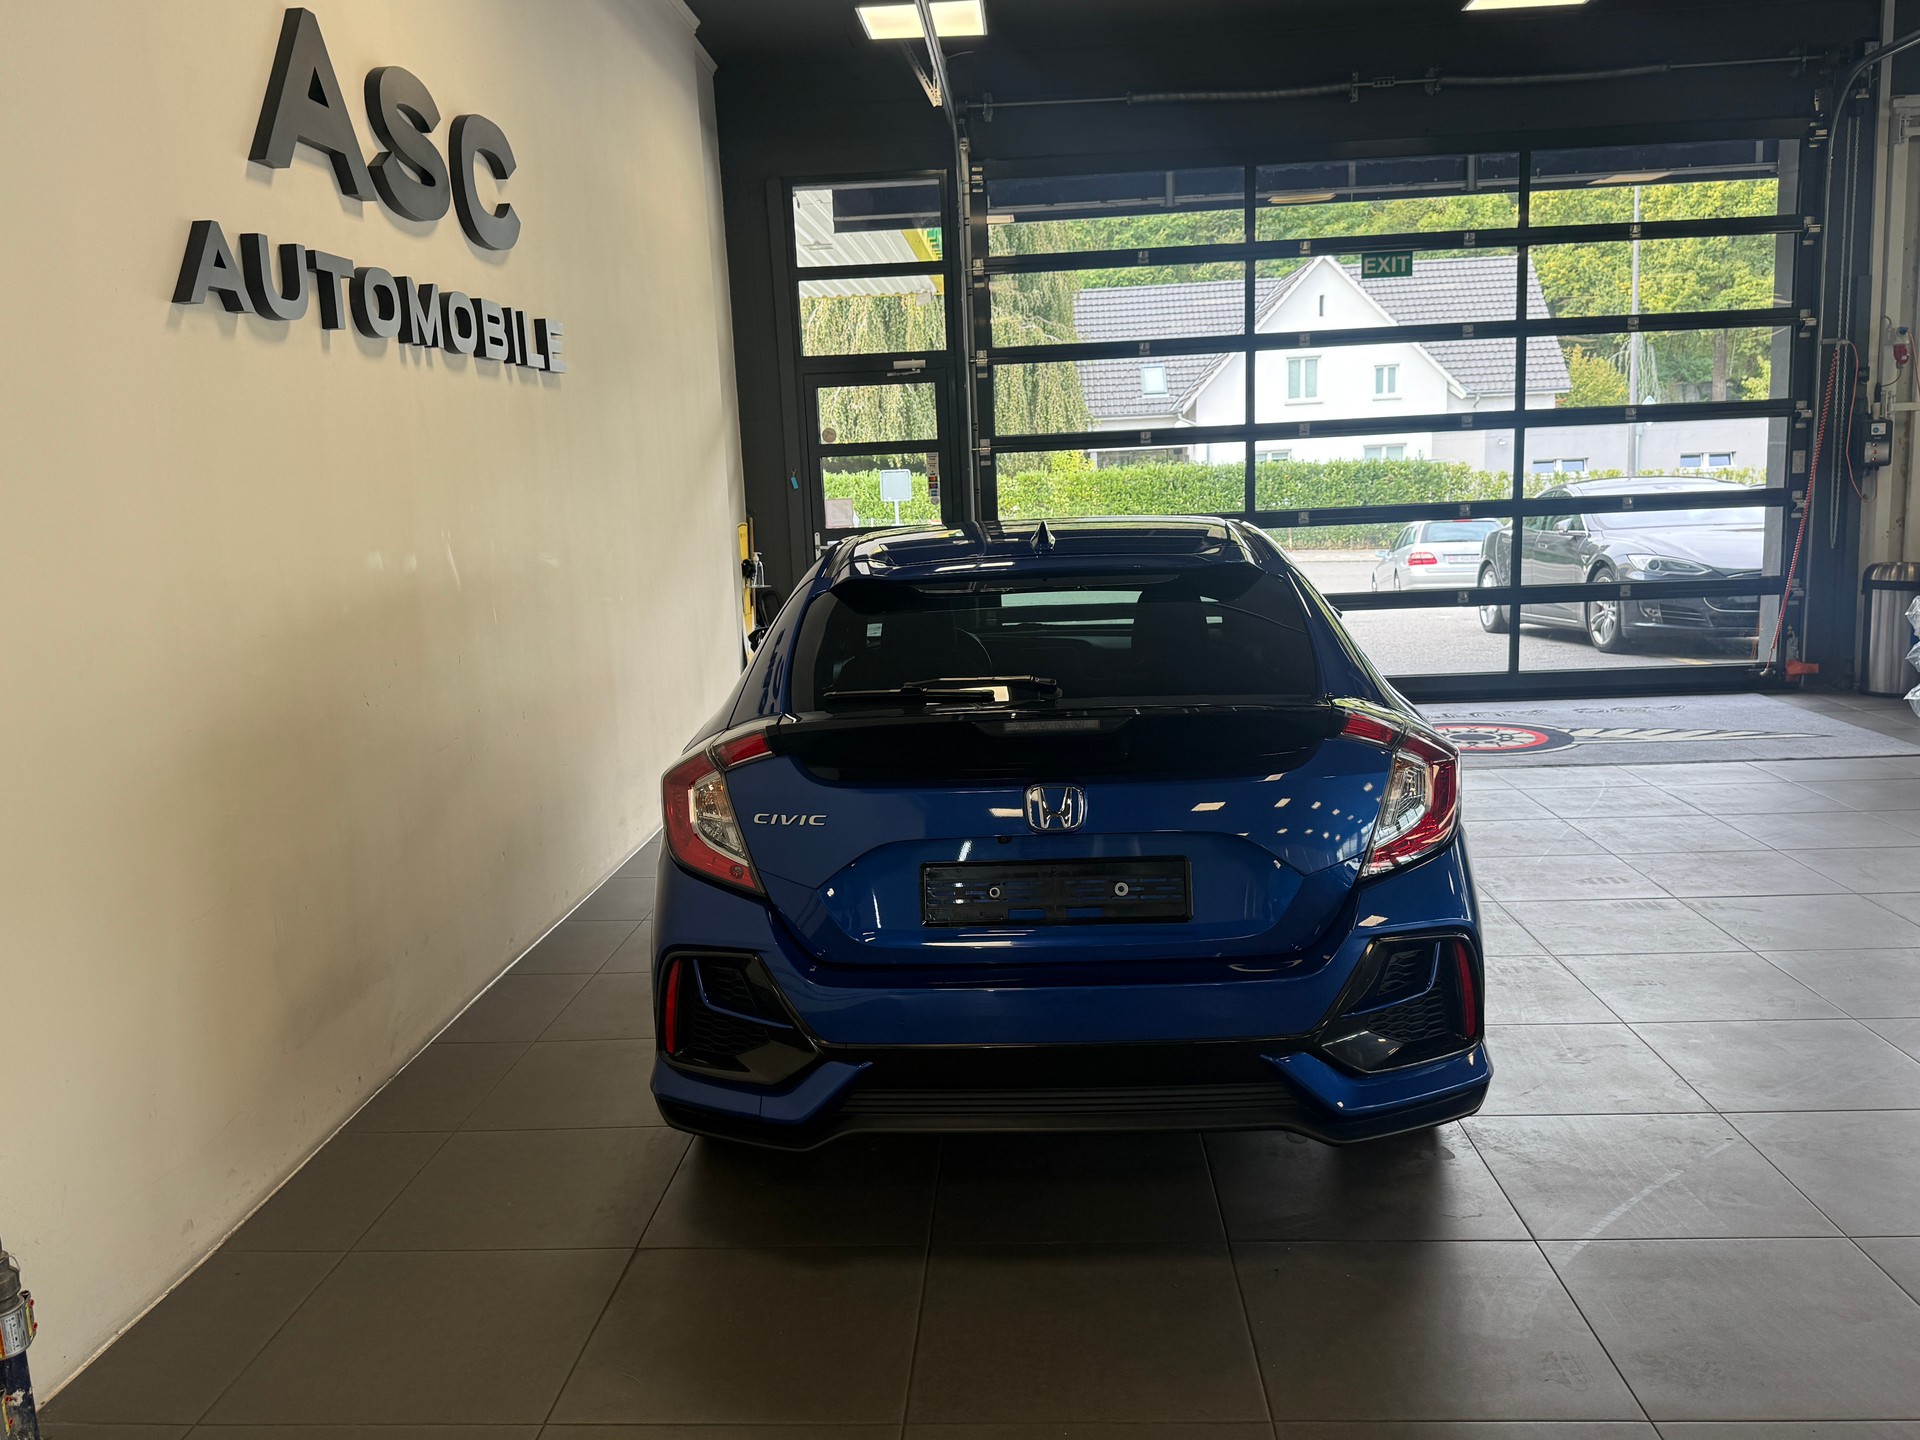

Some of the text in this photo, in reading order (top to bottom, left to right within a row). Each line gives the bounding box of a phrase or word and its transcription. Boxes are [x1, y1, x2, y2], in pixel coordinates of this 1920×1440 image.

[248, 7, 521, 250] ASC
[171, 219, 566, 373] AUTOMOBILE
[1364, 256, 1410, 273] EXIT
[753, 813, 827, 826] CIVIC
